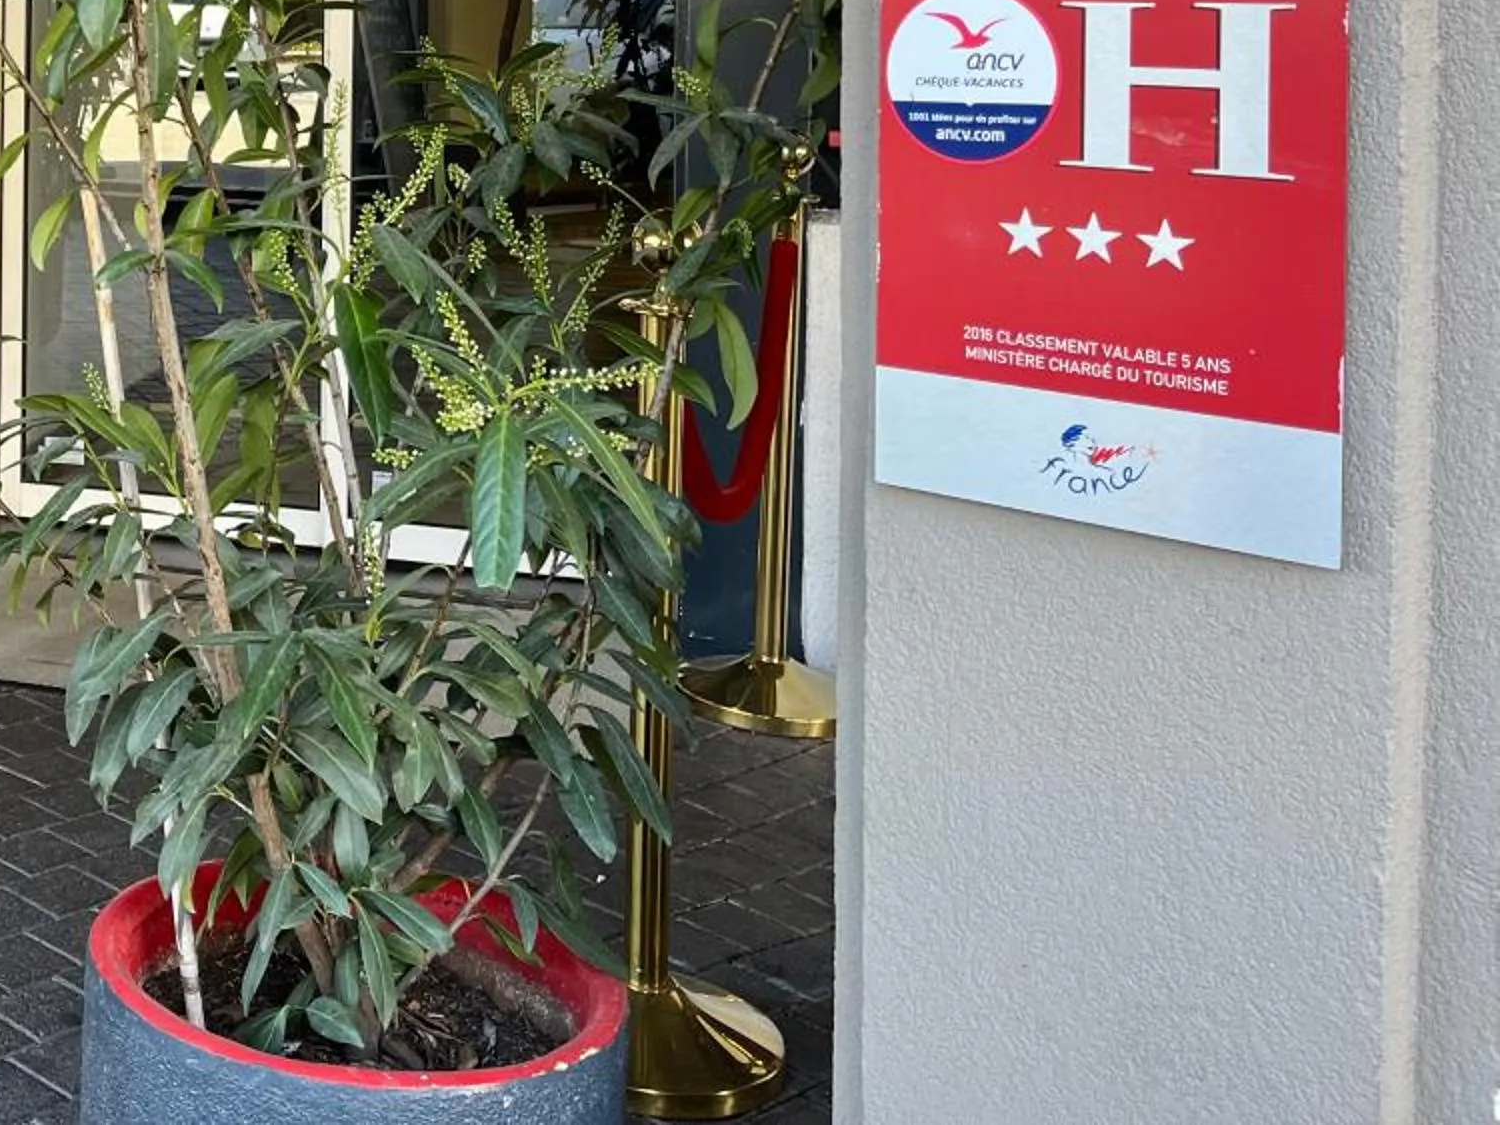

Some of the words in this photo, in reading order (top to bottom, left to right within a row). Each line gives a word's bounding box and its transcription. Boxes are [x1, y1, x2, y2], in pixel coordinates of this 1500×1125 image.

[966, 52, 1025, 71] ancv
[1060, 1, 1297, 181] H
[935, 128, 1006, 142] ancv.com
[954, 114, 973, 124] pour
[1022, 117, 1037, 125] sur
[996, 330, 1099, 356] CLASSEMENT
[1101, 343, 1177, 368] VALABLE
[1181, 353, 1192, 369] 5
[1194, 355, 1232, 374] ANS
[965, 345, 1046, 370] MINISTÈRE
[1048, 356, 1113, 380] CHARGÉ
[1116, 366, 1140, 383] DU
[1143, 370, 1229, 396] TOURISME
